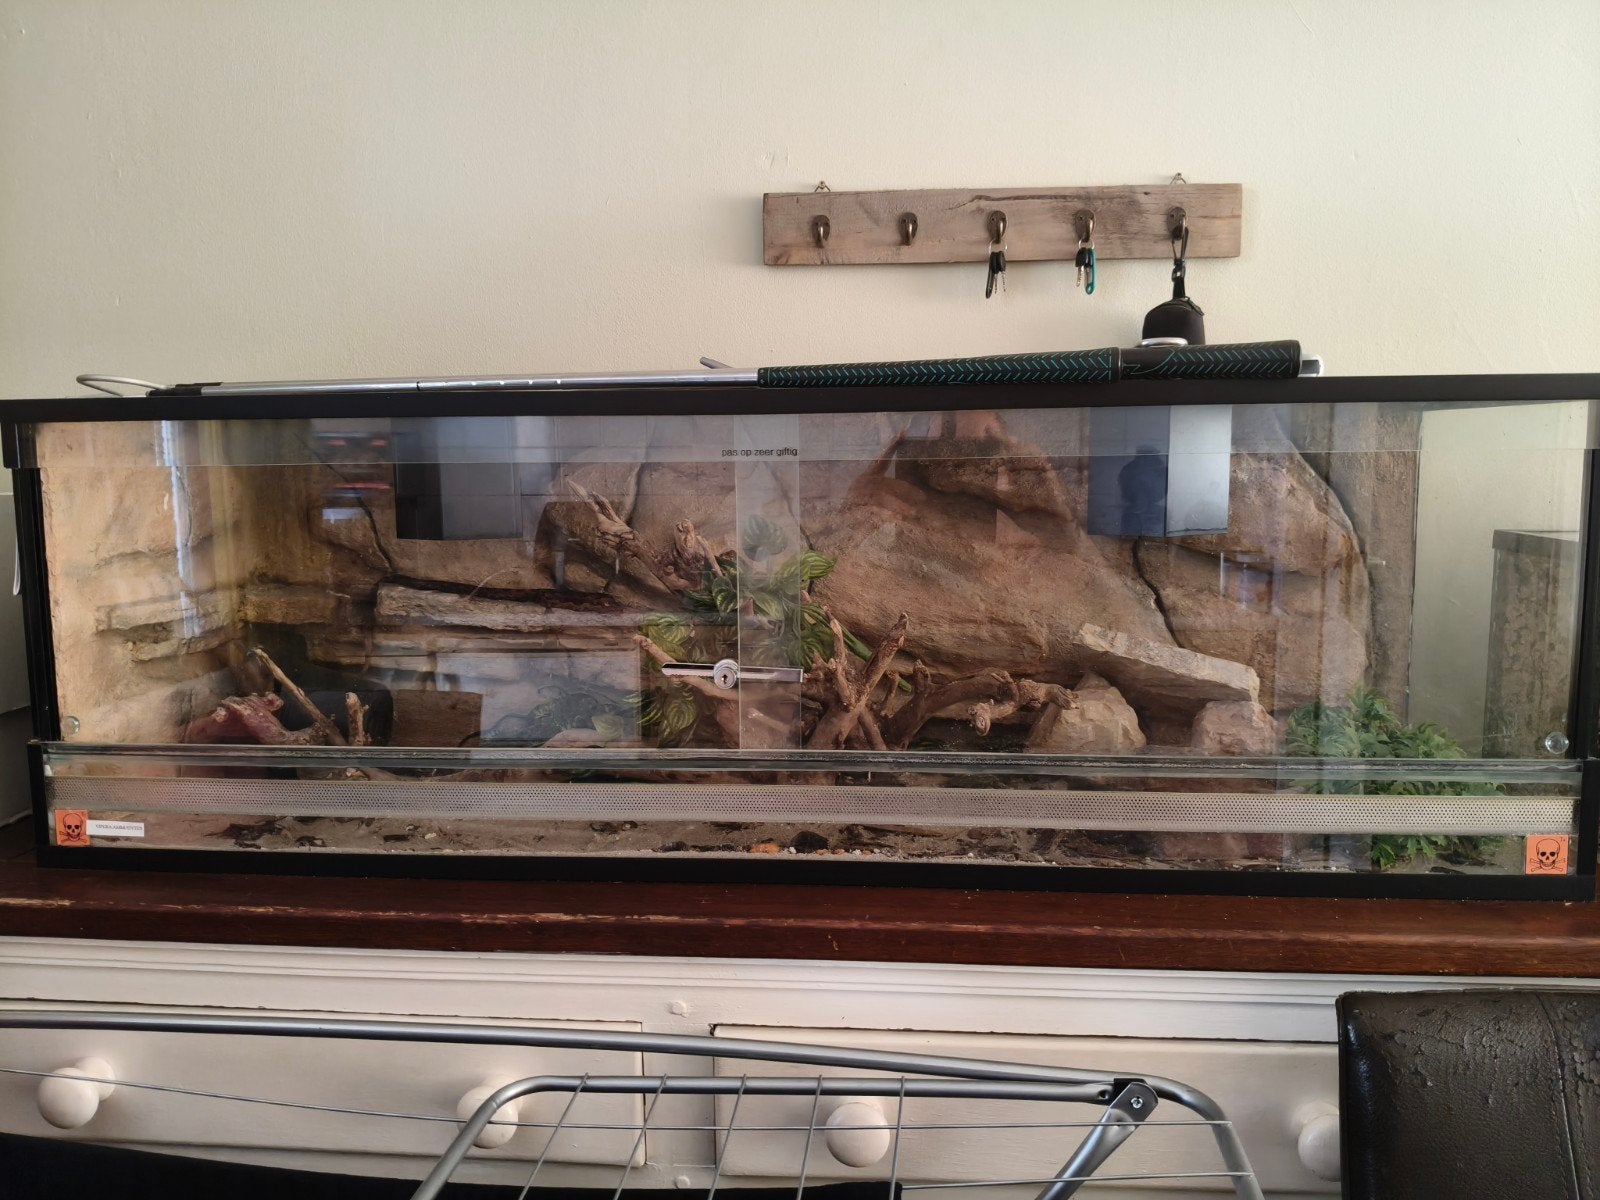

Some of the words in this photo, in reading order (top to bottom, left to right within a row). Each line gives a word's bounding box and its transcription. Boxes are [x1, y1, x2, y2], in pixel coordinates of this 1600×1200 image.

[721, 449, 738, 457] pas
[740, 449, 752, 457] op
[776, 447, 798, 457] giftig
